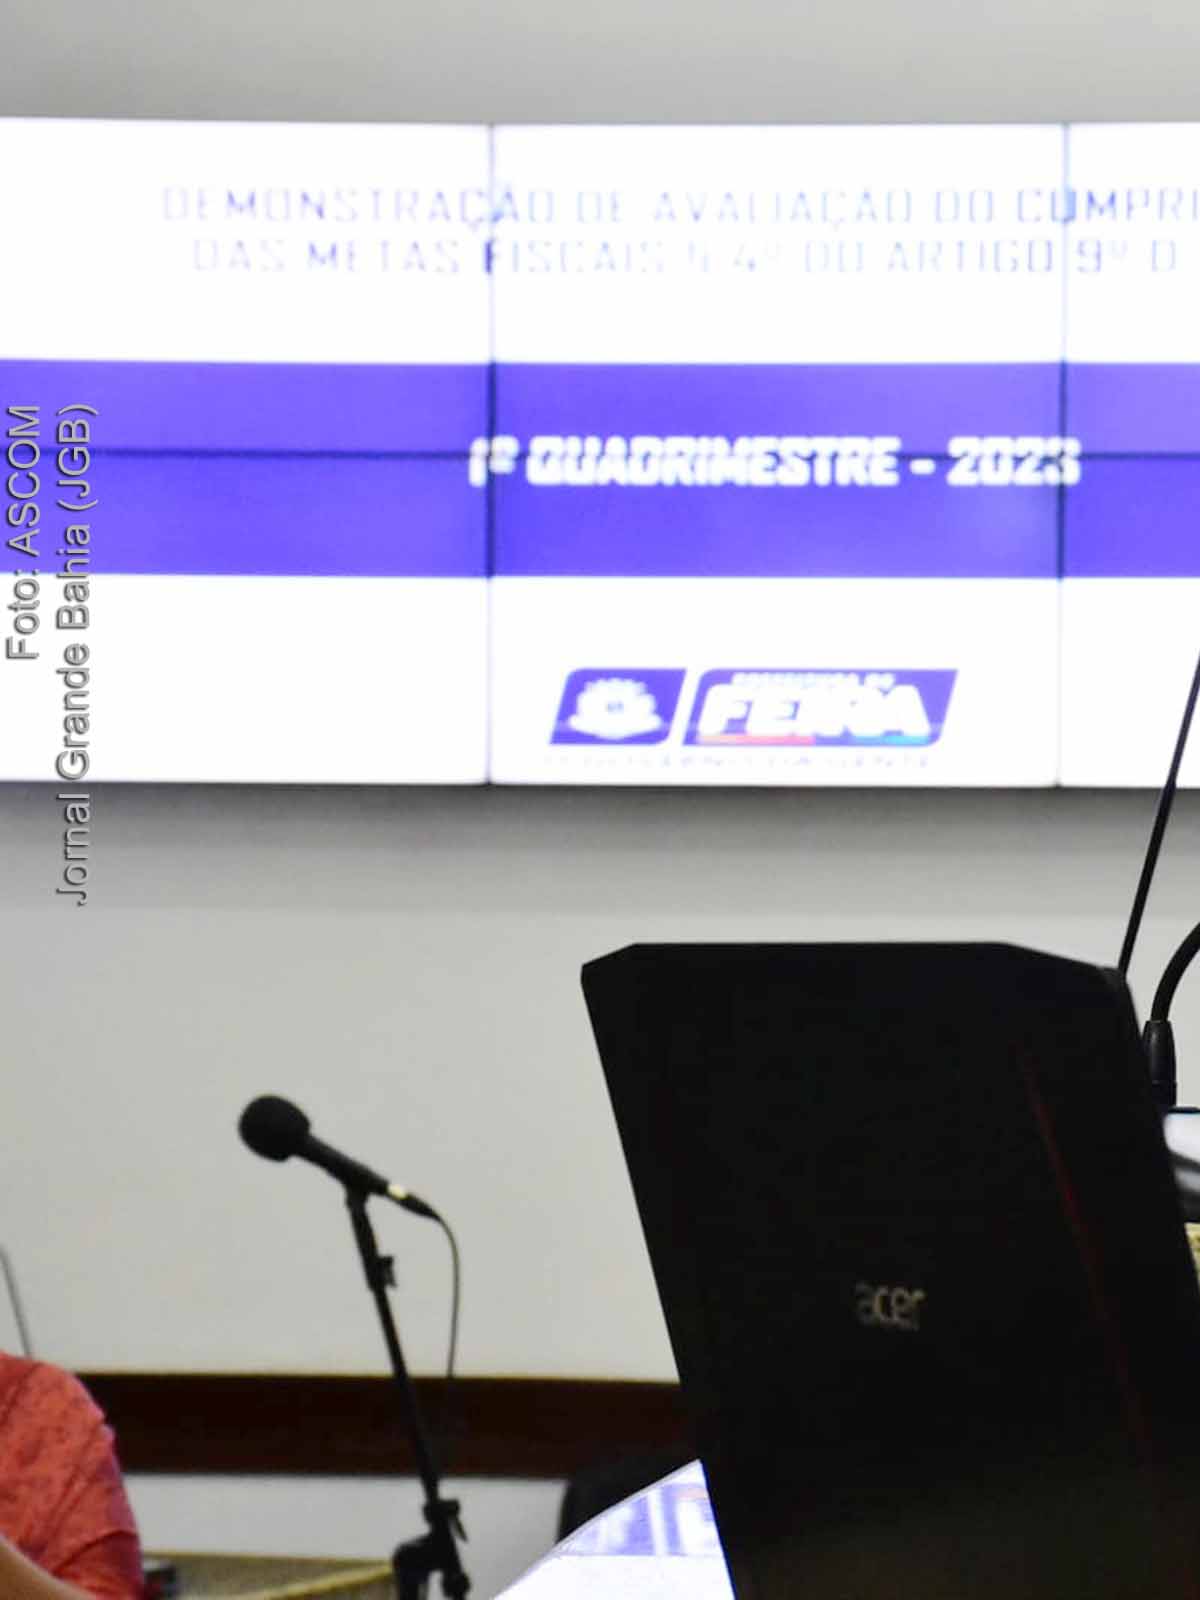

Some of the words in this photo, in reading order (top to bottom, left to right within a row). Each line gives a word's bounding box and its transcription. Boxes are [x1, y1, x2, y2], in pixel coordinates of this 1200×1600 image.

[933, 185, 996, 224] DO
[190, 238, 287, 273] DAS
[887, 238, 1055, 274] ARTIGO
[525, 434, 903, 487] QUADRIMESTRE
[945, 435, 1082, 488] 2023
